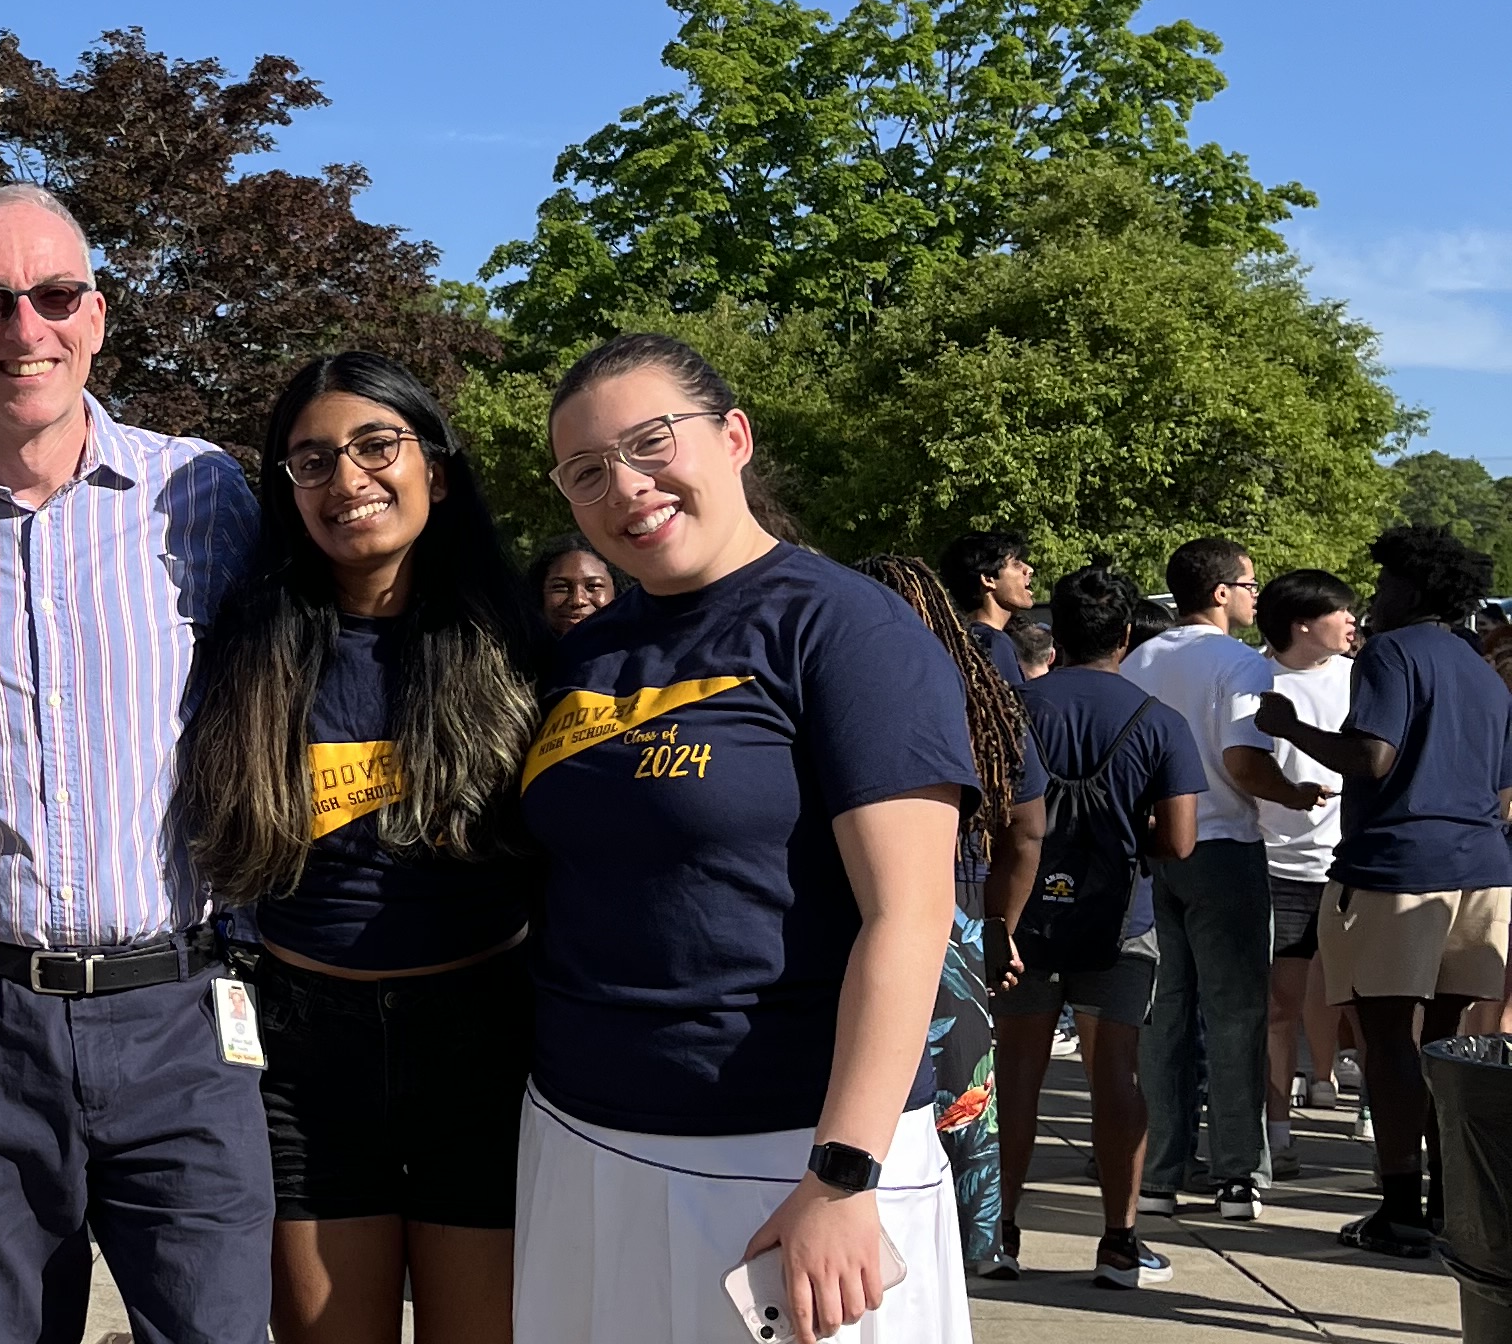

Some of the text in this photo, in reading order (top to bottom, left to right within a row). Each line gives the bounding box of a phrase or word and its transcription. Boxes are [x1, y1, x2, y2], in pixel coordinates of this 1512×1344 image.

[538, 723, 618, 756] HIGH SCHOOL
[624, 723, 679, 745] Class of
[634, 743, 712, 779] 2024
